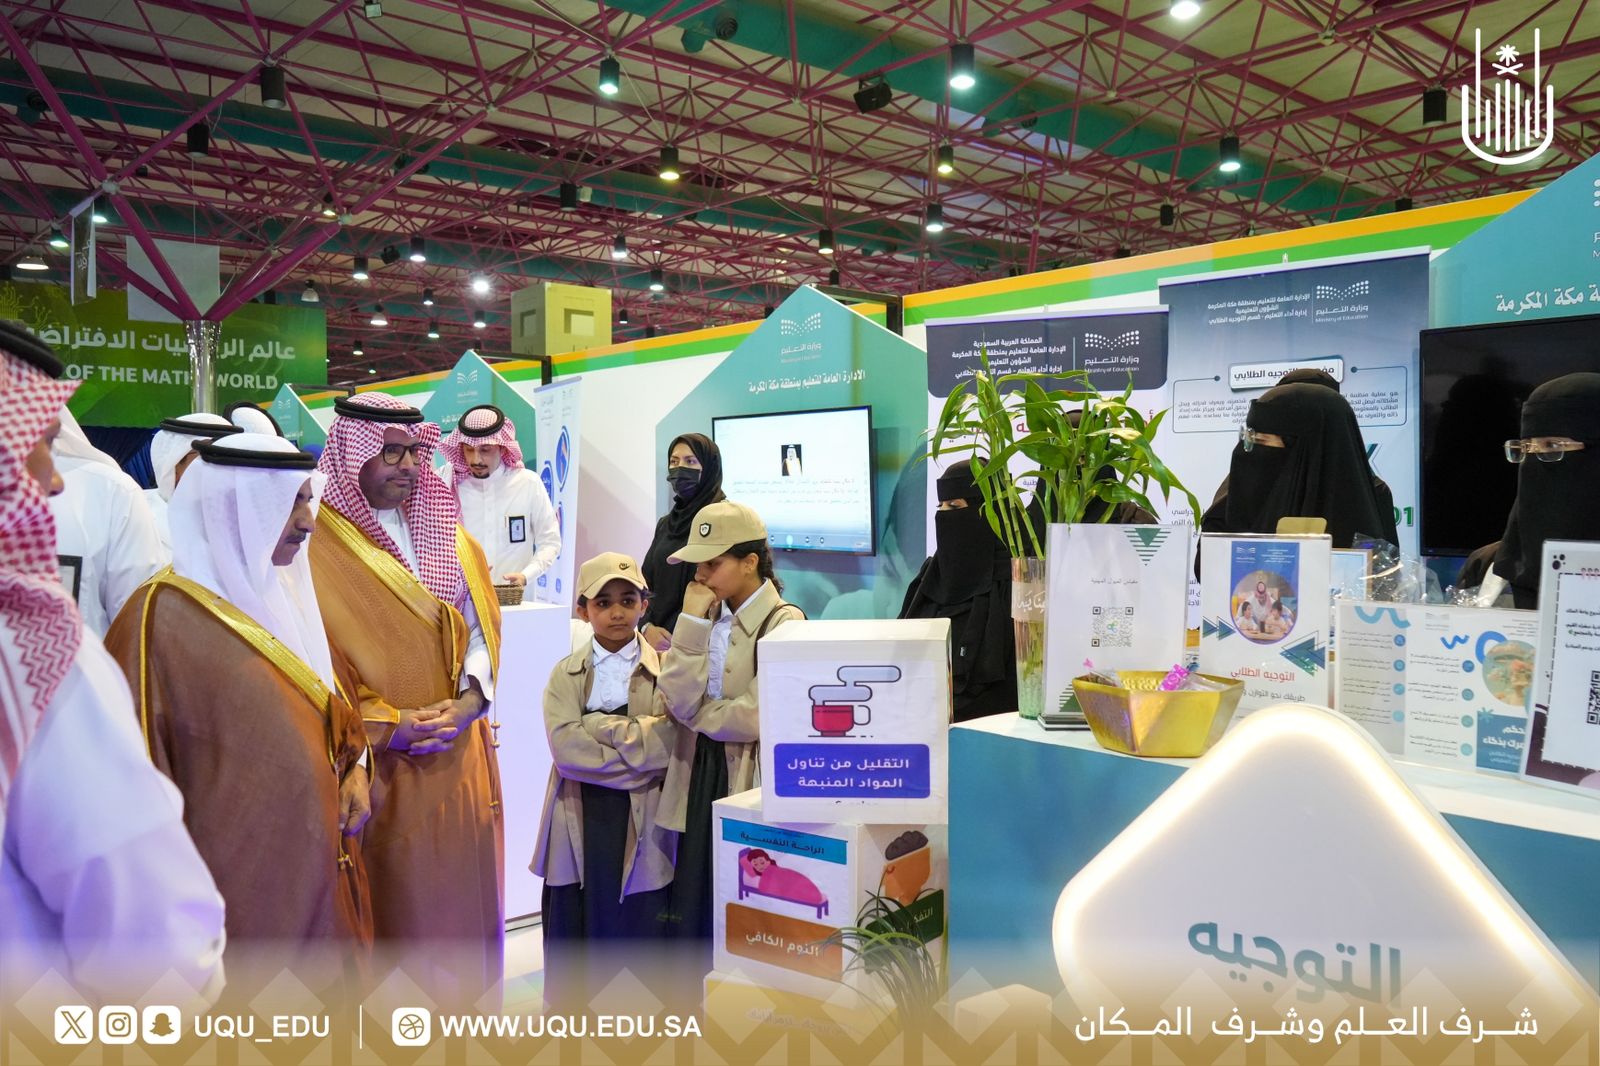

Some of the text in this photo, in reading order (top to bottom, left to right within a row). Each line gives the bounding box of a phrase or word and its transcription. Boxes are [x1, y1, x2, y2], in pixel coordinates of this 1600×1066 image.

[1257, 297, 1277, 305] للتعليم
[1277, 295, 1294, 303] العامة
[1554, 286, 1584, 306] مكة
[1207, 302, 1227, 310] المكرمة
[1350, 305, 1369, 313] وزارة
[1496, 291, 1548, 316] المكرمة
[1000, 338, 1019, 347] العربية
[1019, 336, 1043, 345] المملكة
[248, 341, 296, 362] عالم
[952, 351, 973, 359] المكرمة
[1008, 348, 1028, 357] للتعليم
[1048, 345, 1066, 354] الإدارة
[1010, 357, 1031, 365] الشؤون
[1085, 355, 1140, 366] وزارة التعليم
[66, 364, 94, 380] OF
[98, 366, 138, 383] THE
[997, 368, 1012, 376] قسم
[1049, 365, 1063, 373] إدارة
[822, 372, 842, 383] العامة
[1234, 370, 1266, 380] الطلابي
[768, 379, 779, 390] مكة
[780, 377, 801, 390] بمنطقة
[802, 374, 822, 389] للتعليم
[748, 381, 768, 395] المكرمة
[1231, 667, 1295, 683] التوجيه الطلابي
[787, 757, 910, 773] التقليل من تناول
[797, 776, 903, 792] المواد المنبهة
[740, 832, 789, 847] النفسية
[791, 841, 825, 854] الراحة
[745, 931, 820, 958] النوم الكافي
[1187, 920, 1402, 1008] التوجيه
